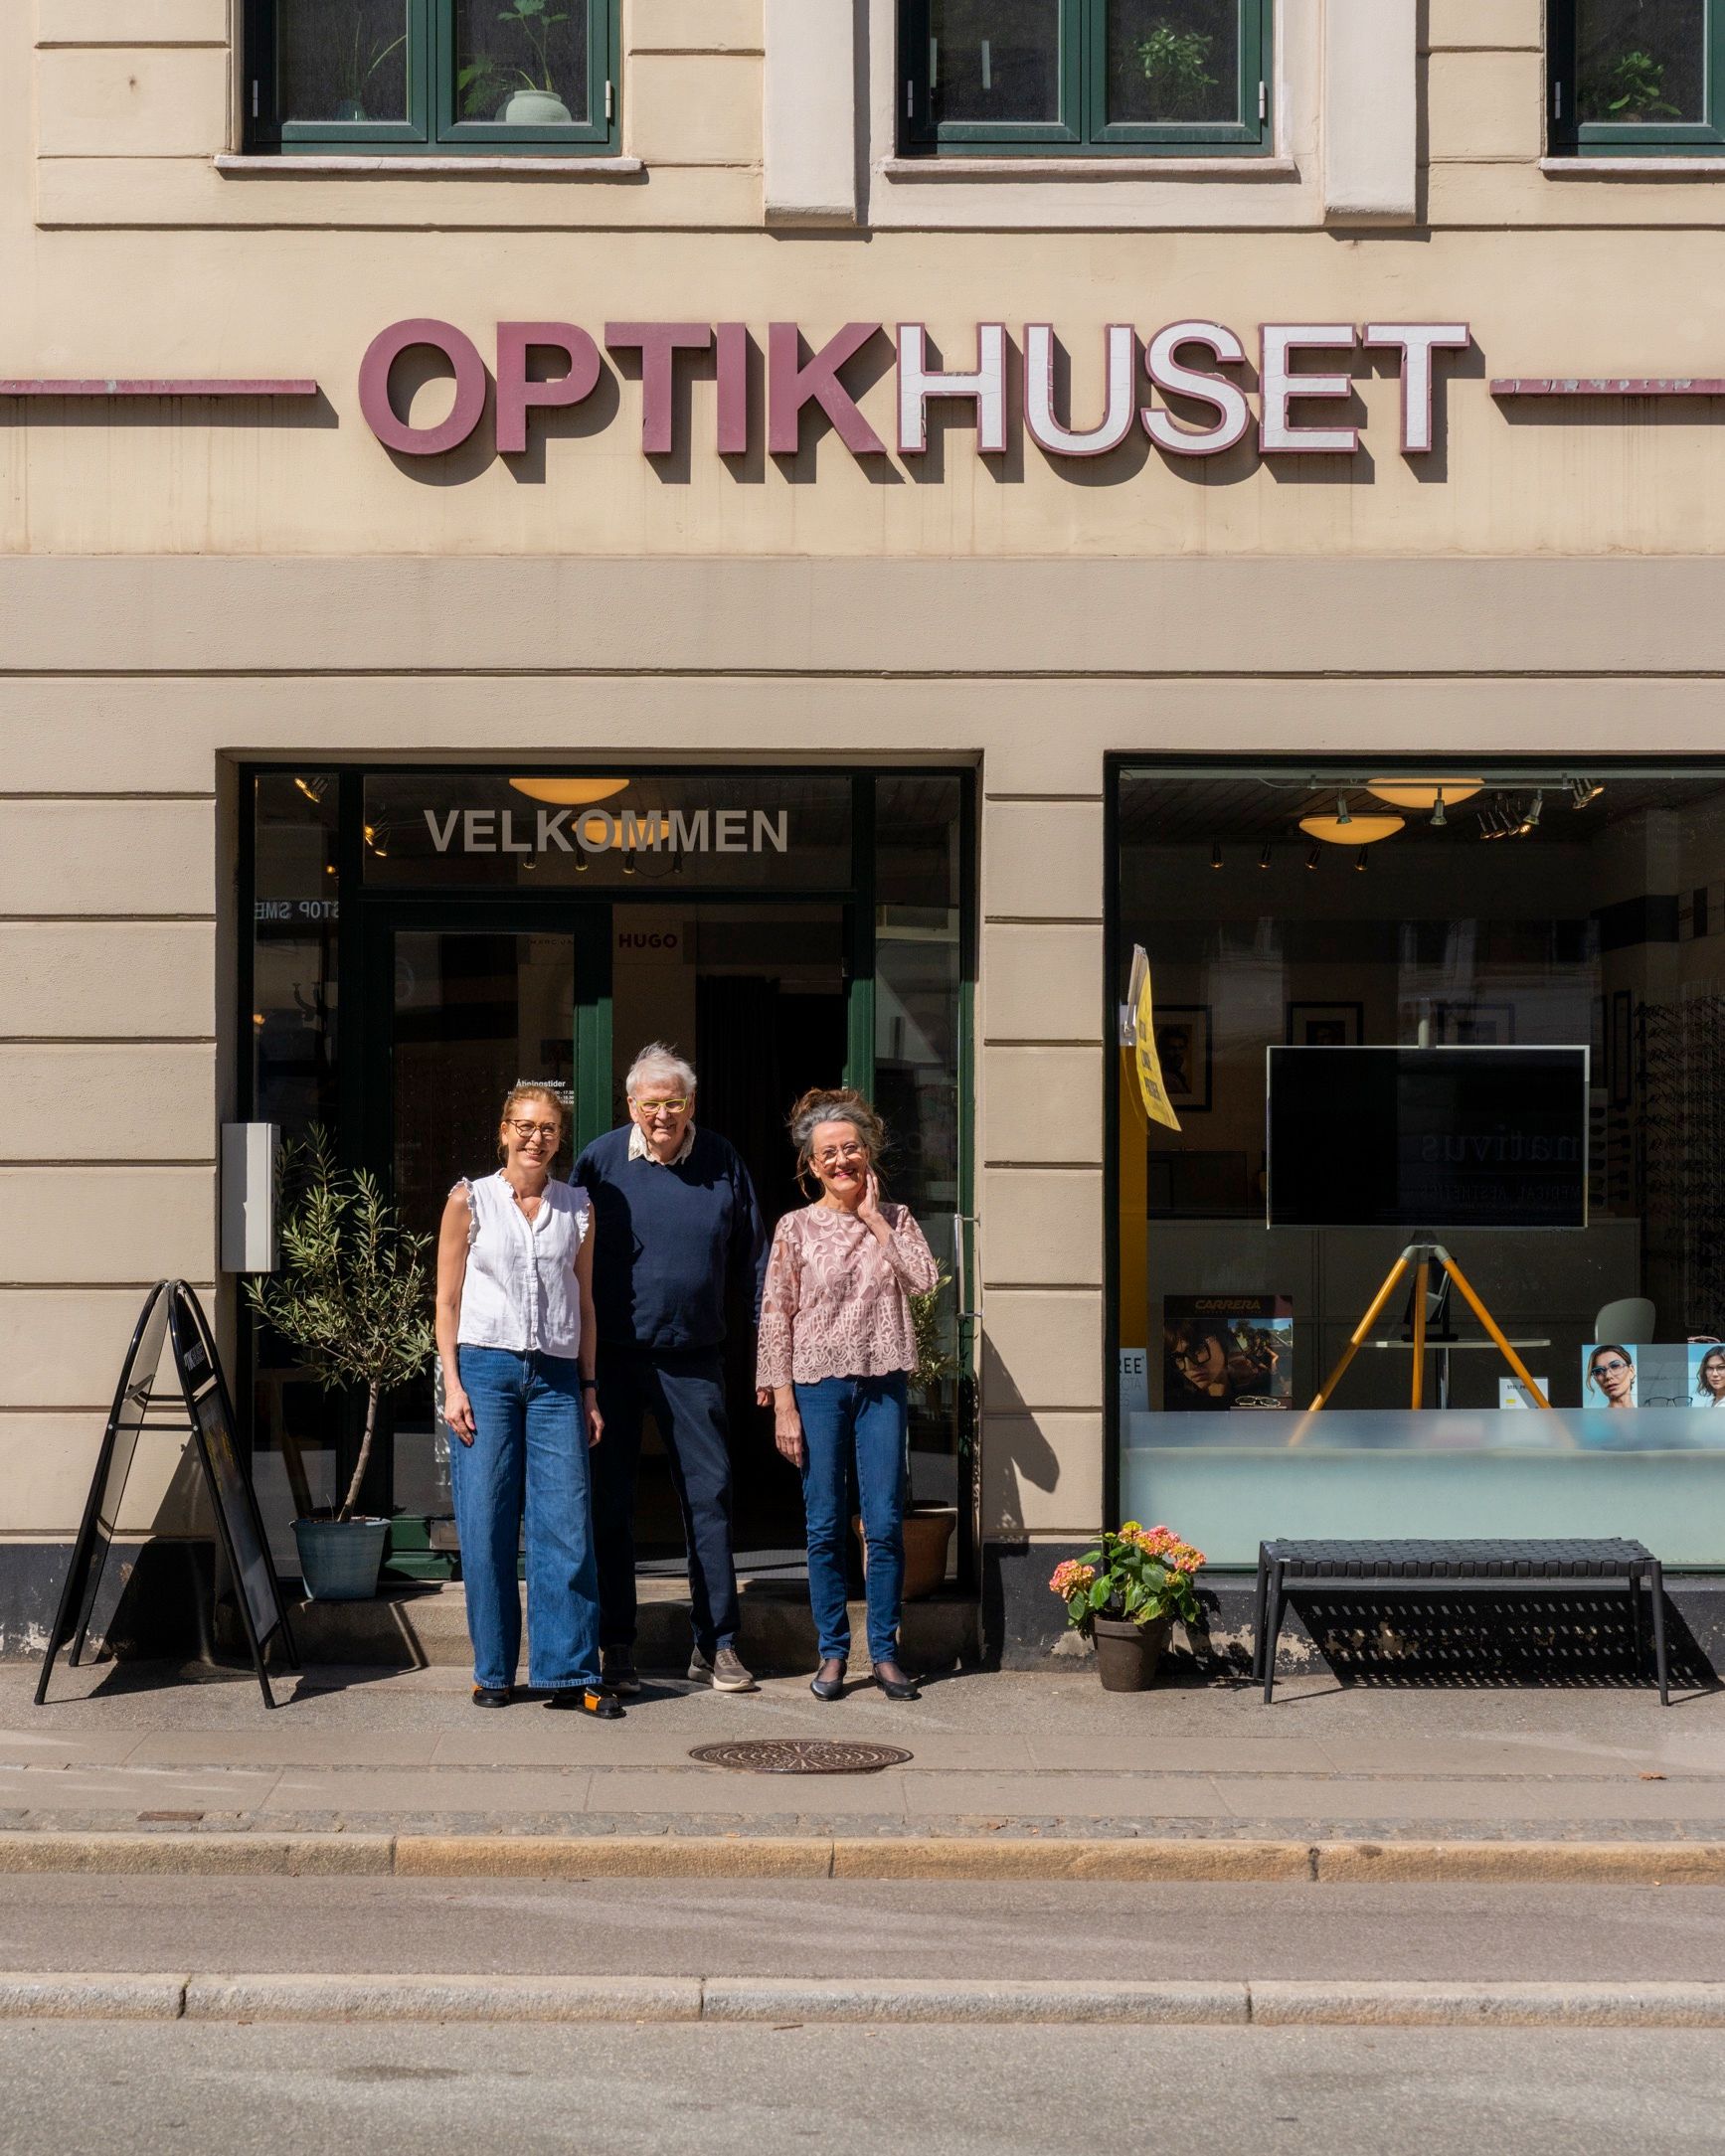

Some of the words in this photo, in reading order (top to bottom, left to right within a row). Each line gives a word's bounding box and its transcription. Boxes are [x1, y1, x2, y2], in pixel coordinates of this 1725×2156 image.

[359, 318, 1470, 456] OPTIKHUSET
[425, 809, 787, 853] VELKOMMEN
[618, 933, 677, 948] HUGO
[1195, 1299, 1262, 1310] CARRERA
